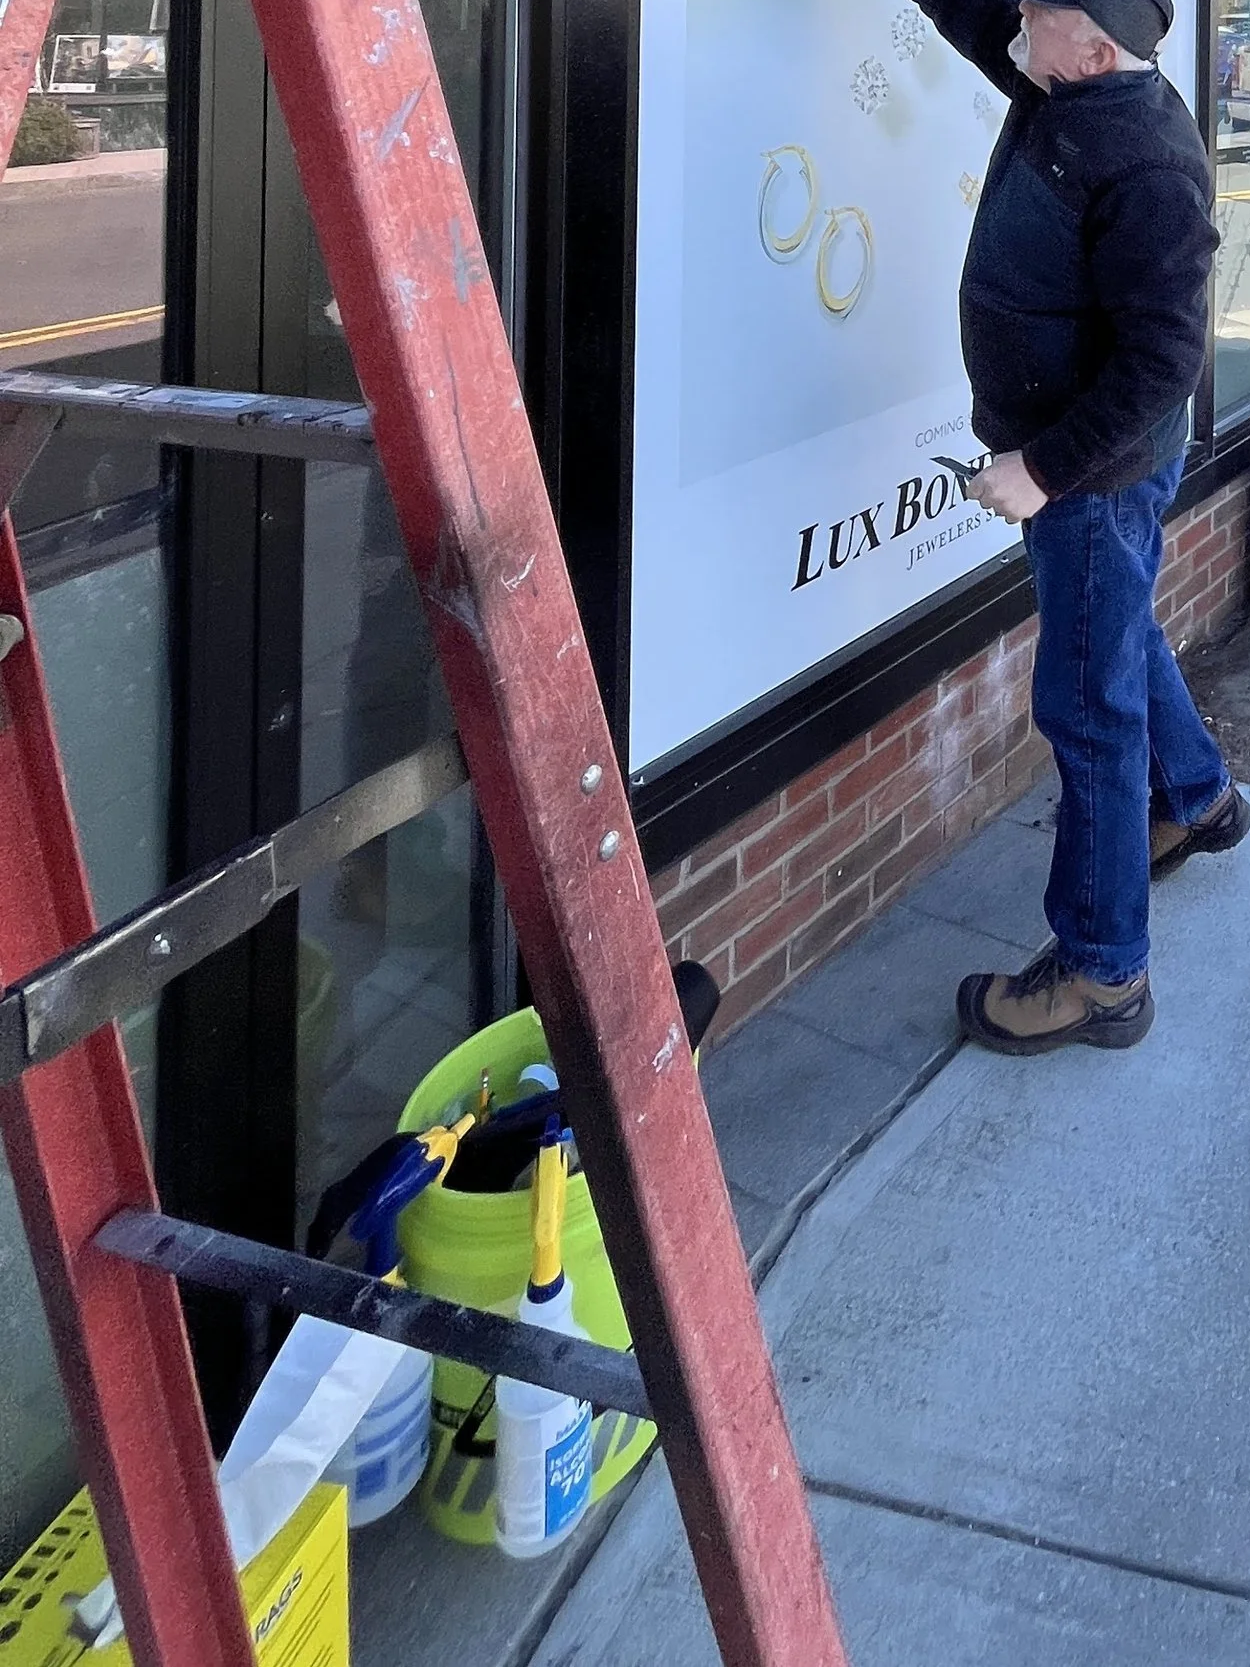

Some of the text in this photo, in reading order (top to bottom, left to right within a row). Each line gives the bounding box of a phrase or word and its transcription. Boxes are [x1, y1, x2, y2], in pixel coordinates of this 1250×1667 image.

[915, 415, 964, 448] COMING
[790, 501, 884, 592] LUX
[906, 516, 982, 572] JEWELERS
[561, 1461, 586, 1498] 70
[255, 1565, 304, 1644] RAGS
